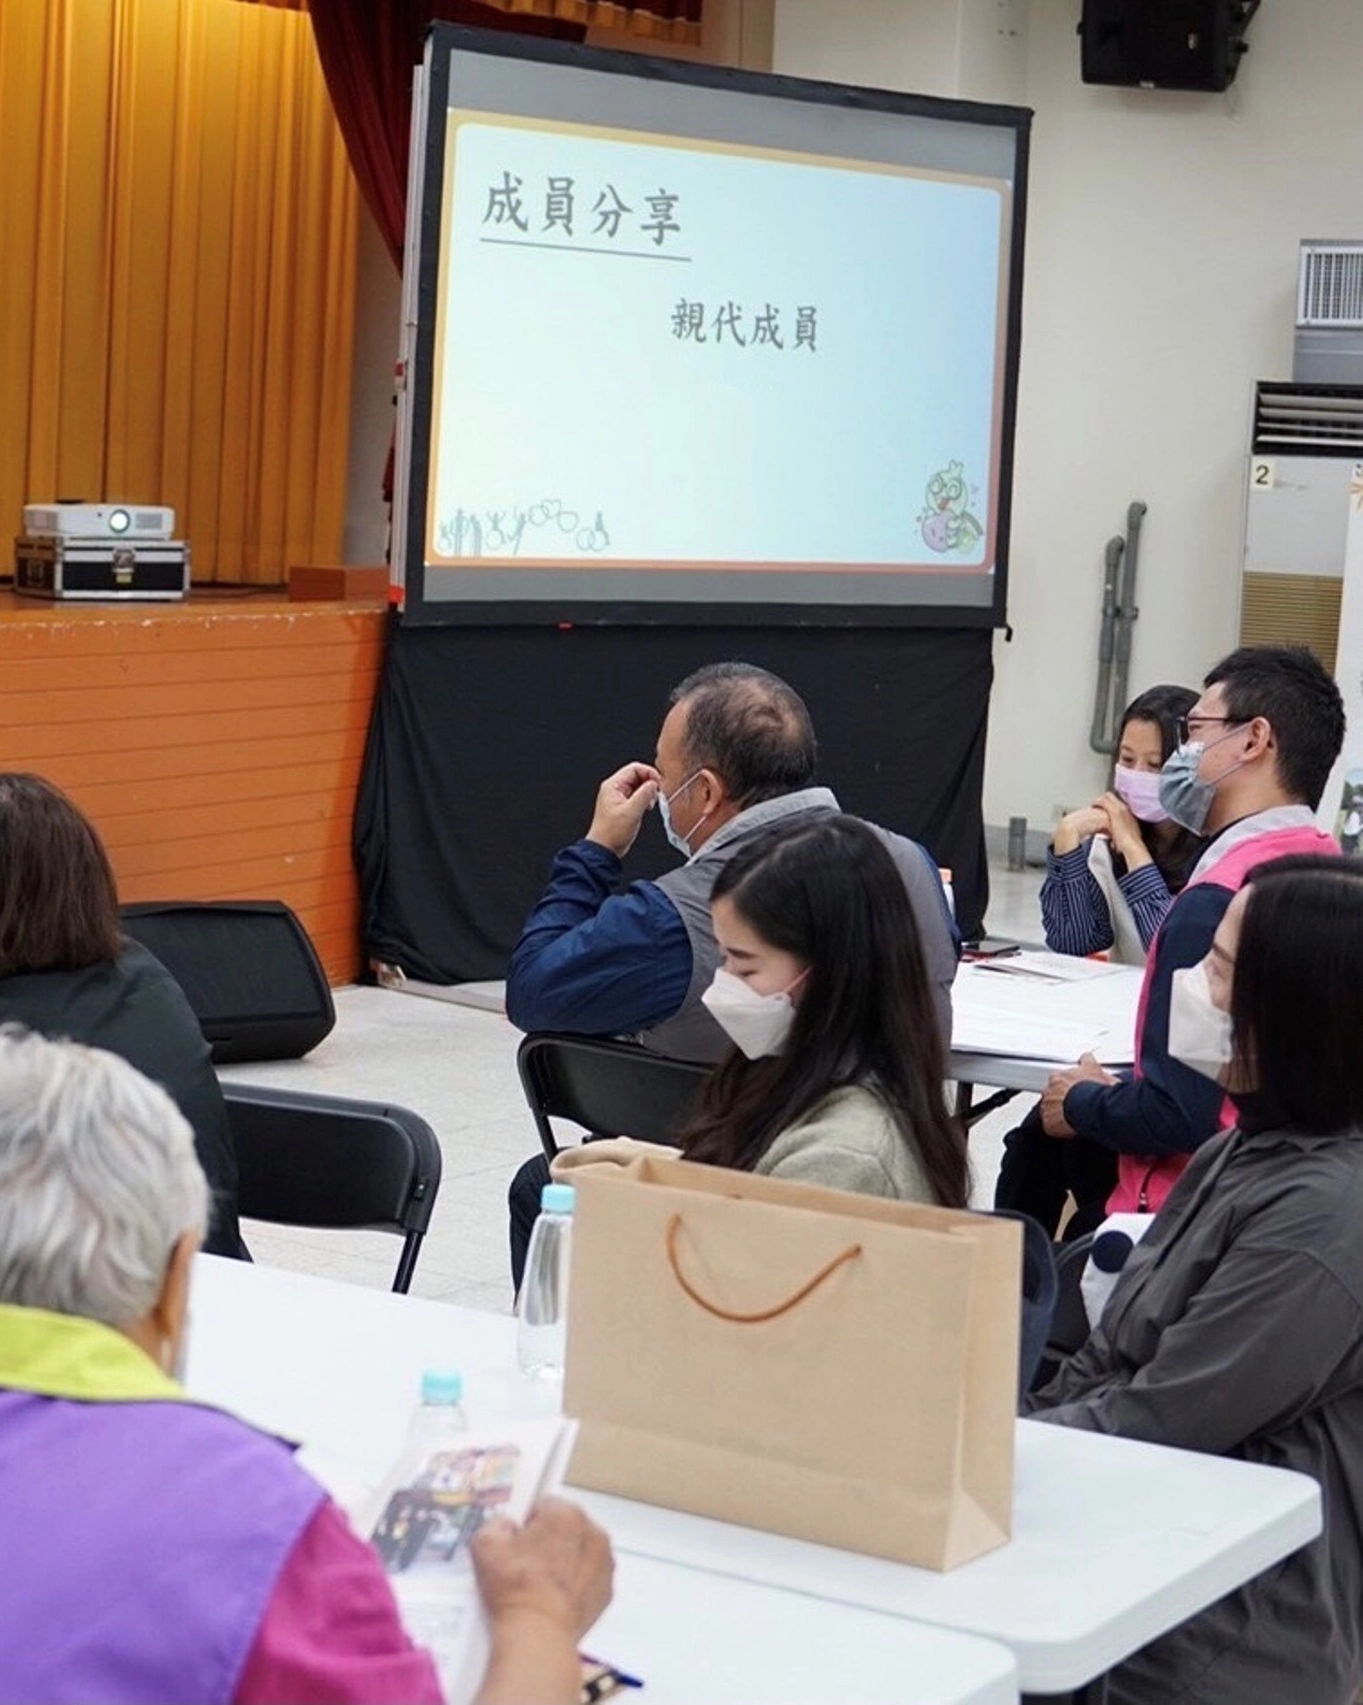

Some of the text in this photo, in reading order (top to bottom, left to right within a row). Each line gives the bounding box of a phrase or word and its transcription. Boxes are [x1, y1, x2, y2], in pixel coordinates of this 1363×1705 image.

[482, 170, 682, 247] 成員分享
[670, 297, 819, 352] 親代成員
[1256, 465, 1269, 485] 2
